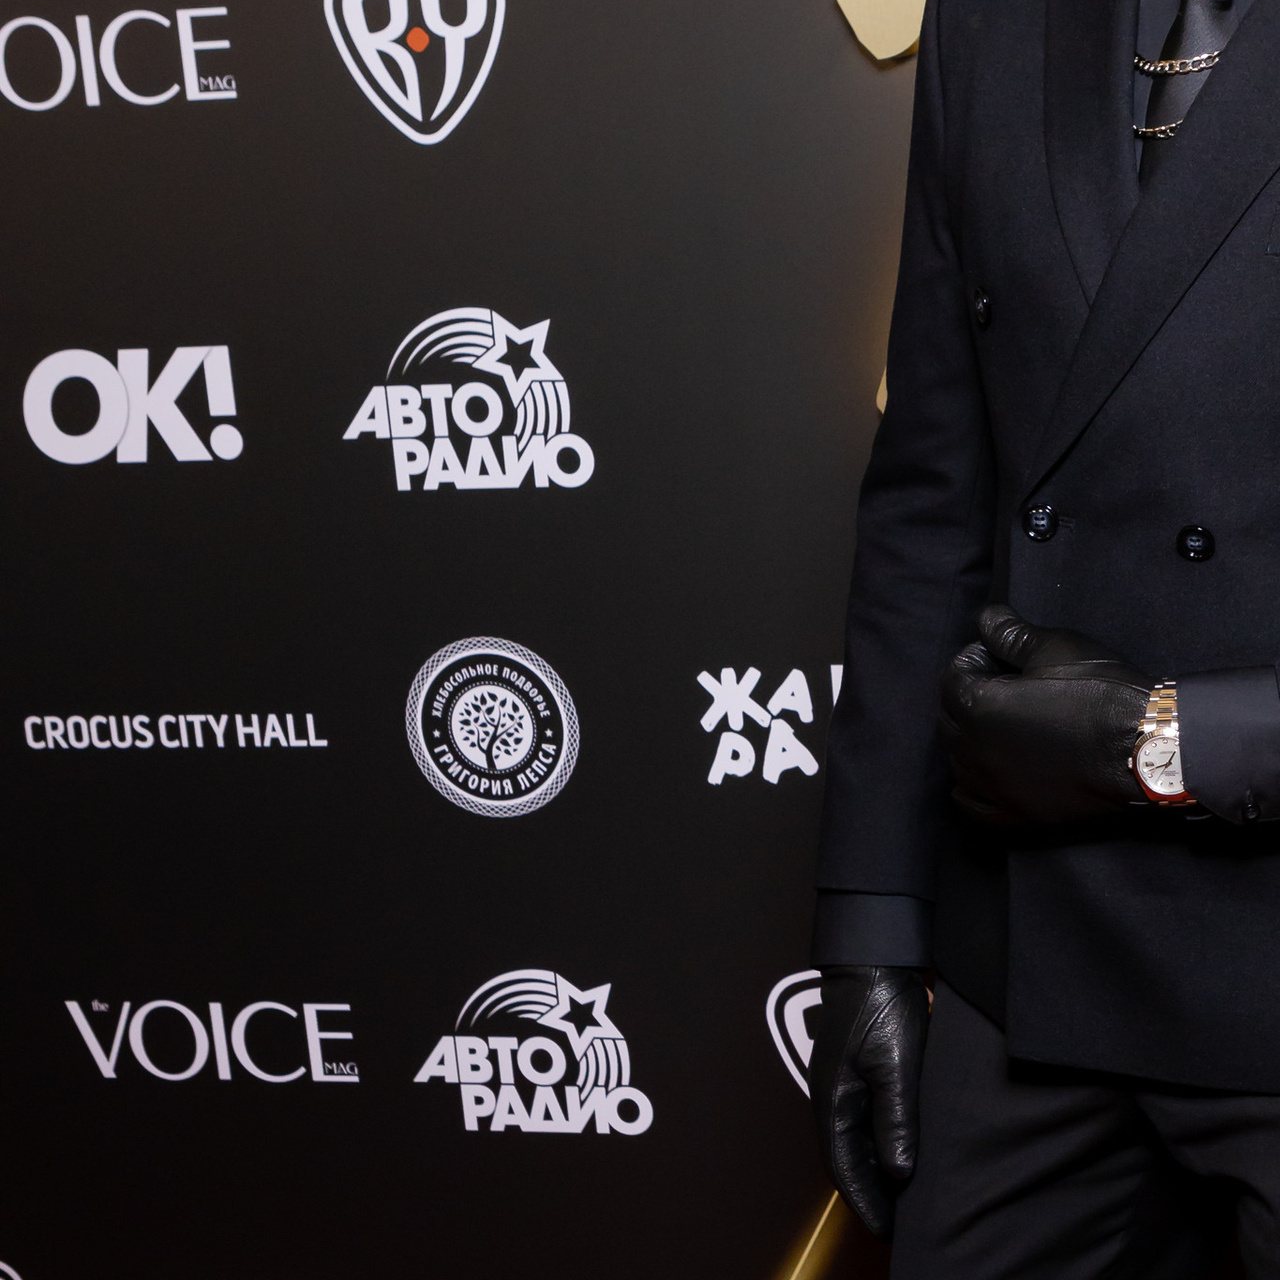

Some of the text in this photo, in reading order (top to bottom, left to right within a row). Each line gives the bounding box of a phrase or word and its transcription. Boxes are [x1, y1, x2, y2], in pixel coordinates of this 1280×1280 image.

[200, 74, 236, 91] MAG
[23, 346, 244, 465] OK!
[342, 381, 504, 440] АВТО
[391, 433, 595, 492] РАДИО
[431, 663, 551, 719] ХЛЕБОСОЛЬНОЕ ПОДВОРЬЕ
[25, 713, 328, 750] CROCUS CITY HALL
[433, 743, 557, 796] ГРИГОРИЯ ЛЕПСА
[64, 1000, 360, 1083] VOICE
[413, 1035, 567, 1086] АВТО
[324, 1062, 359, 1075] MAG
[460, 1085, 654, 1136] РАДИО
